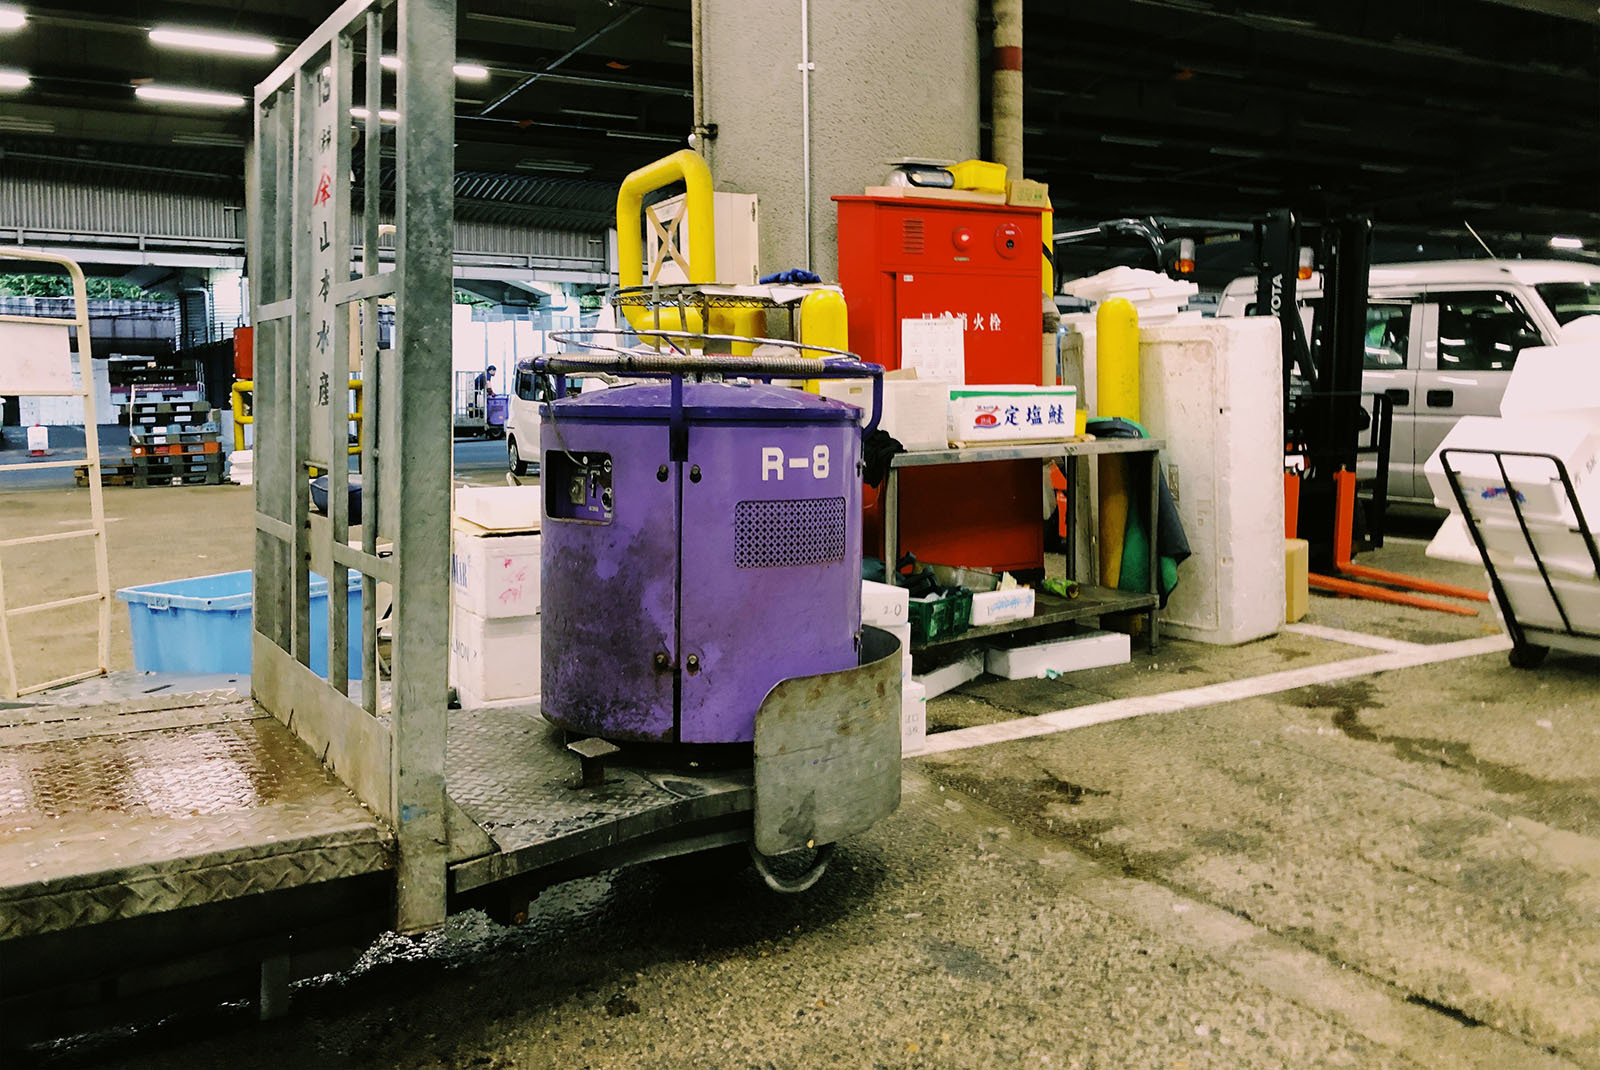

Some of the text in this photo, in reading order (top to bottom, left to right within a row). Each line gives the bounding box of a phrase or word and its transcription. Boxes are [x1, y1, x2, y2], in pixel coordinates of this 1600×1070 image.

[316, 220, 331, 407] 山本水産
[1004, 403, 1065, 426] 定塩鮭
[761, 444, 830, 481] R-8
